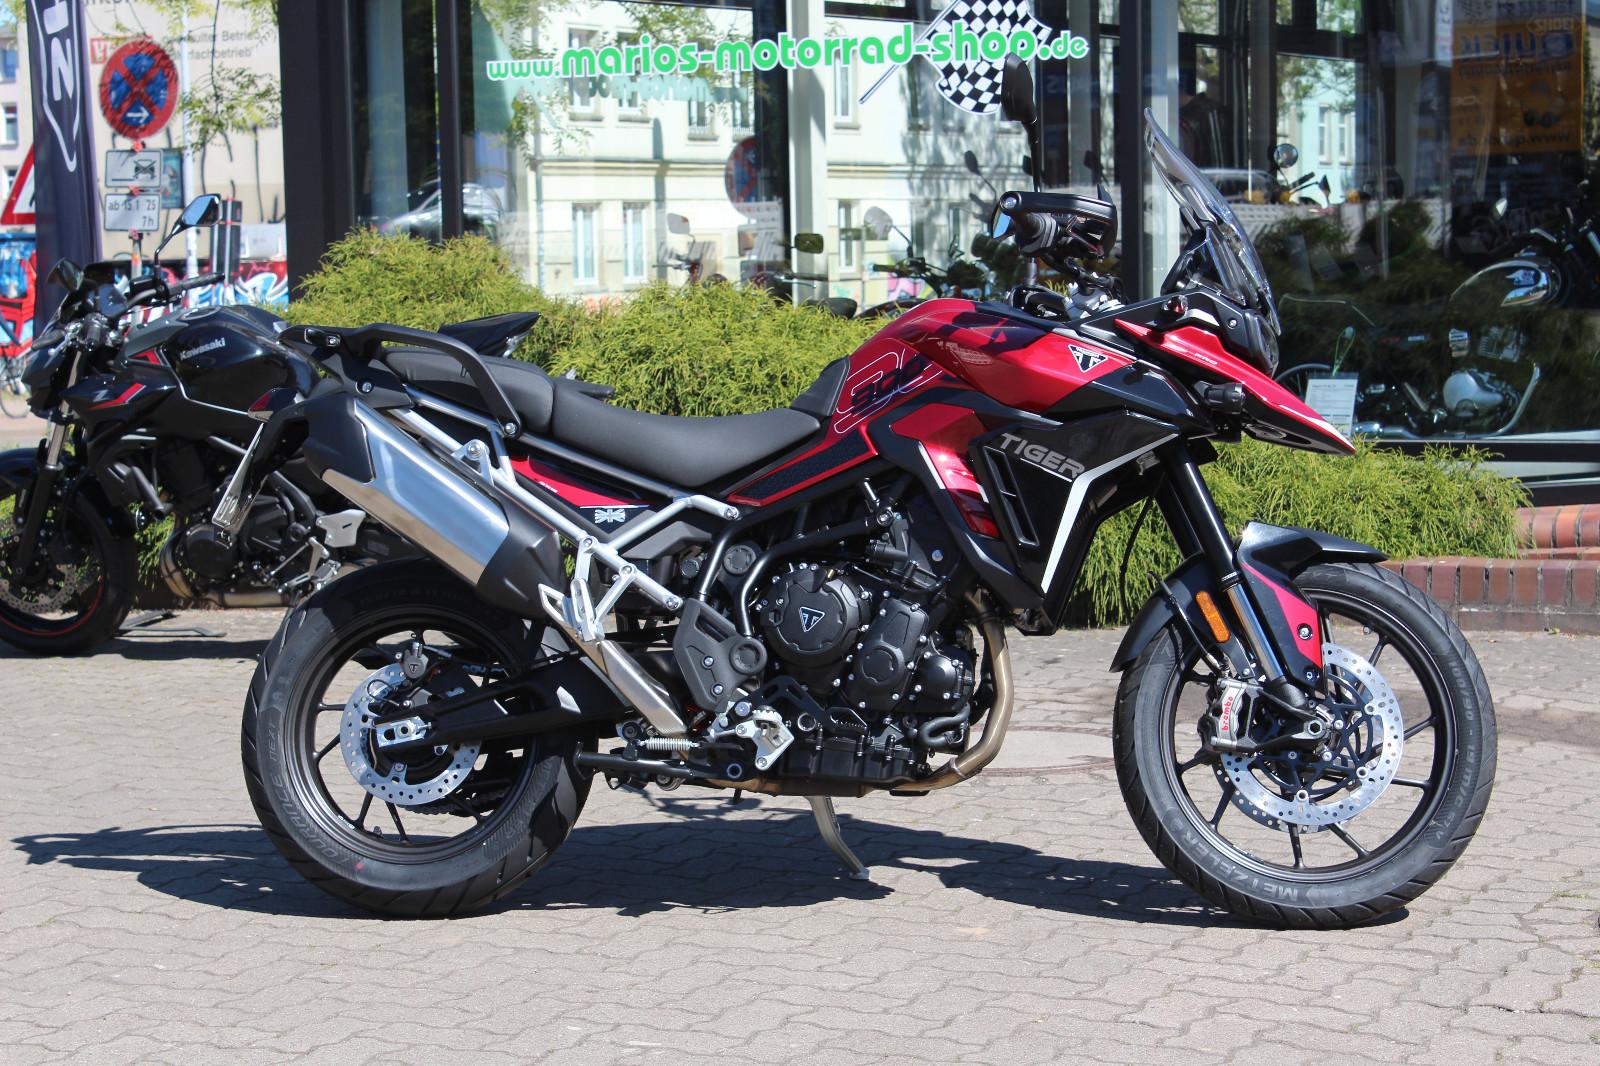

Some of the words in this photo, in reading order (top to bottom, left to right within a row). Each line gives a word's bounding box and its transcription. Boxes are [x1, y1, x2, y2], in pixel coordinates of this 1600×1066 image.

[487, 22, 1090, 80] www.marios-motorrad-shop.de
[180, 337, 226, 360] Kawasaki
[1000, 433, 1085, 479] TIGER
[1221, 696, 1233, 731] brembo
[1183, 831, 1298, 903] METZELER
